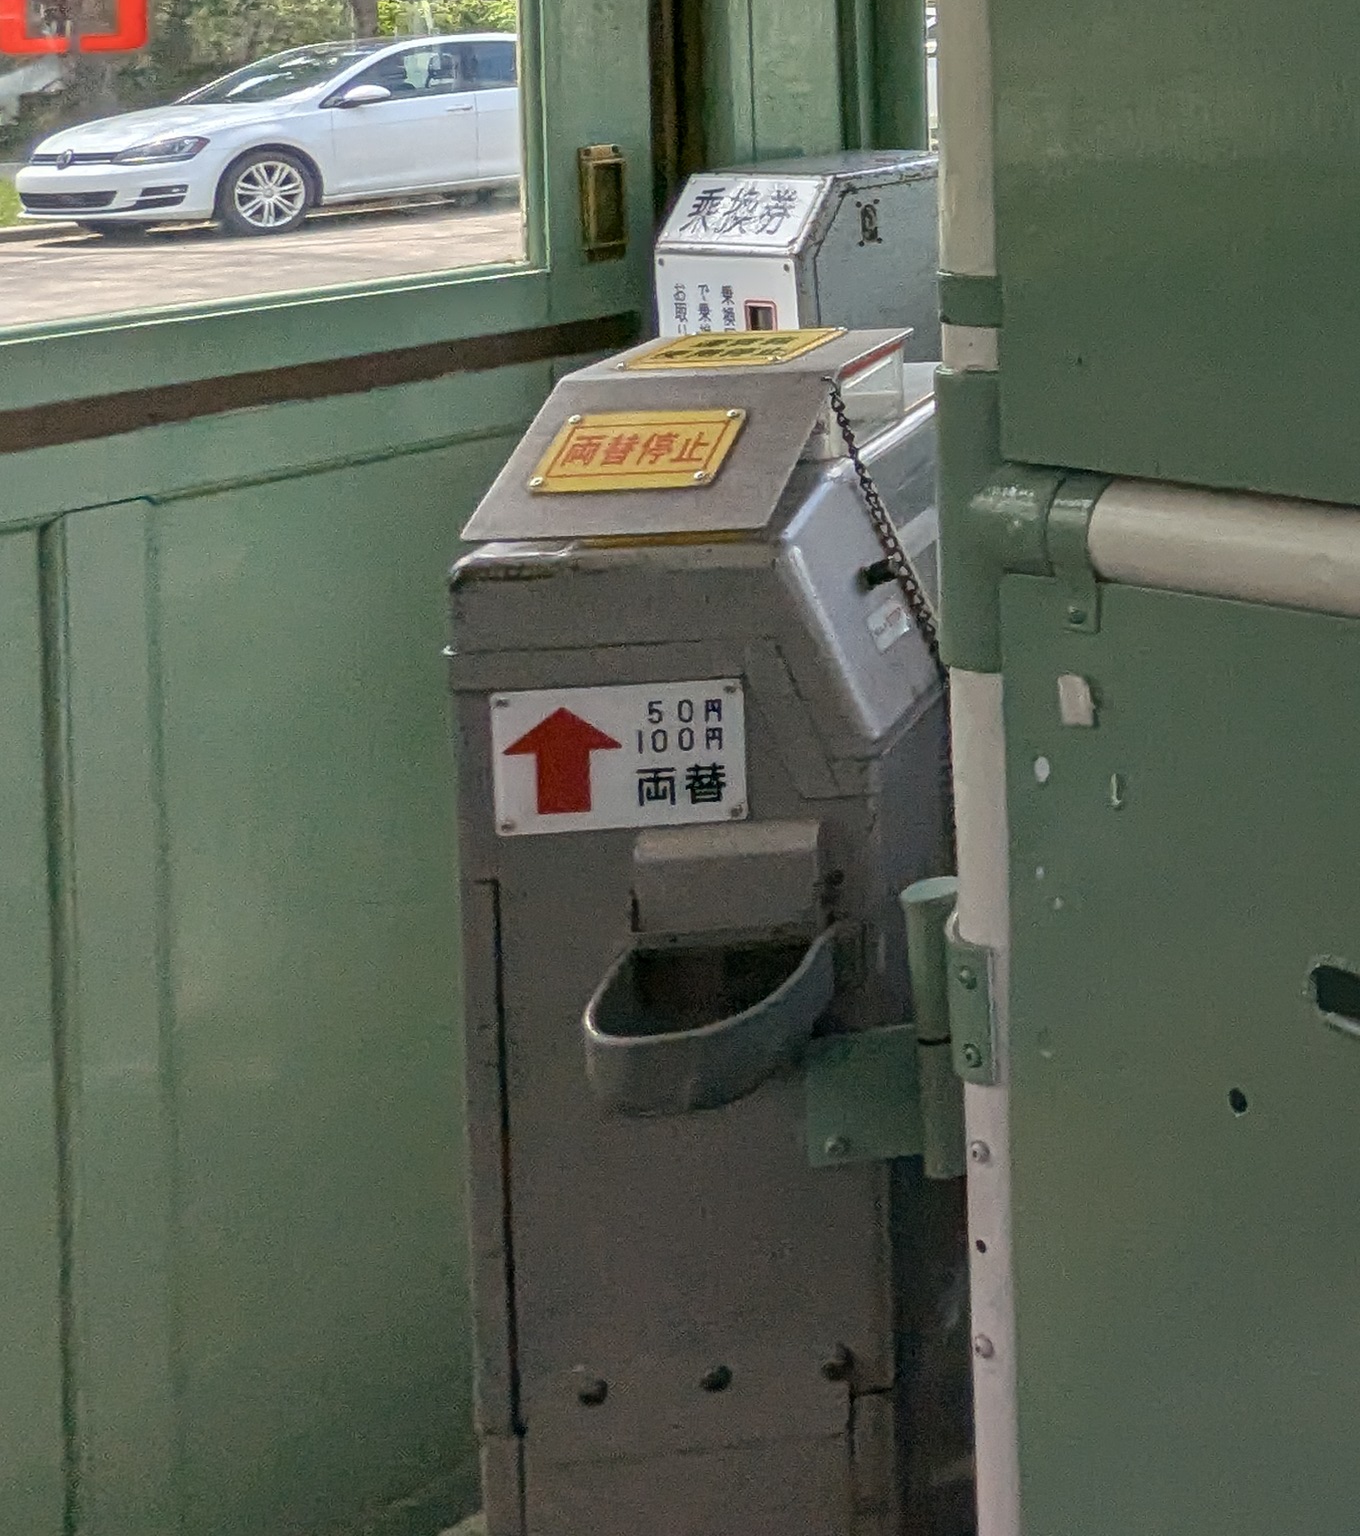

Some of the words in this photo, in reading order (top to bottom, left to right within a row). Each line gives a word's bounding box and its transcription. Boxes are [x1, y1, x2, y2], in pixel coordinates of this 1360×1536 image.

[679, 187, 798, 235] 乗換券
[561, 431, 710, 467] 両替停止
[647, 698, 723, 724] 50円
[637, 727, 724, 754] 100円
[636, 763, 727, 807] 両替
